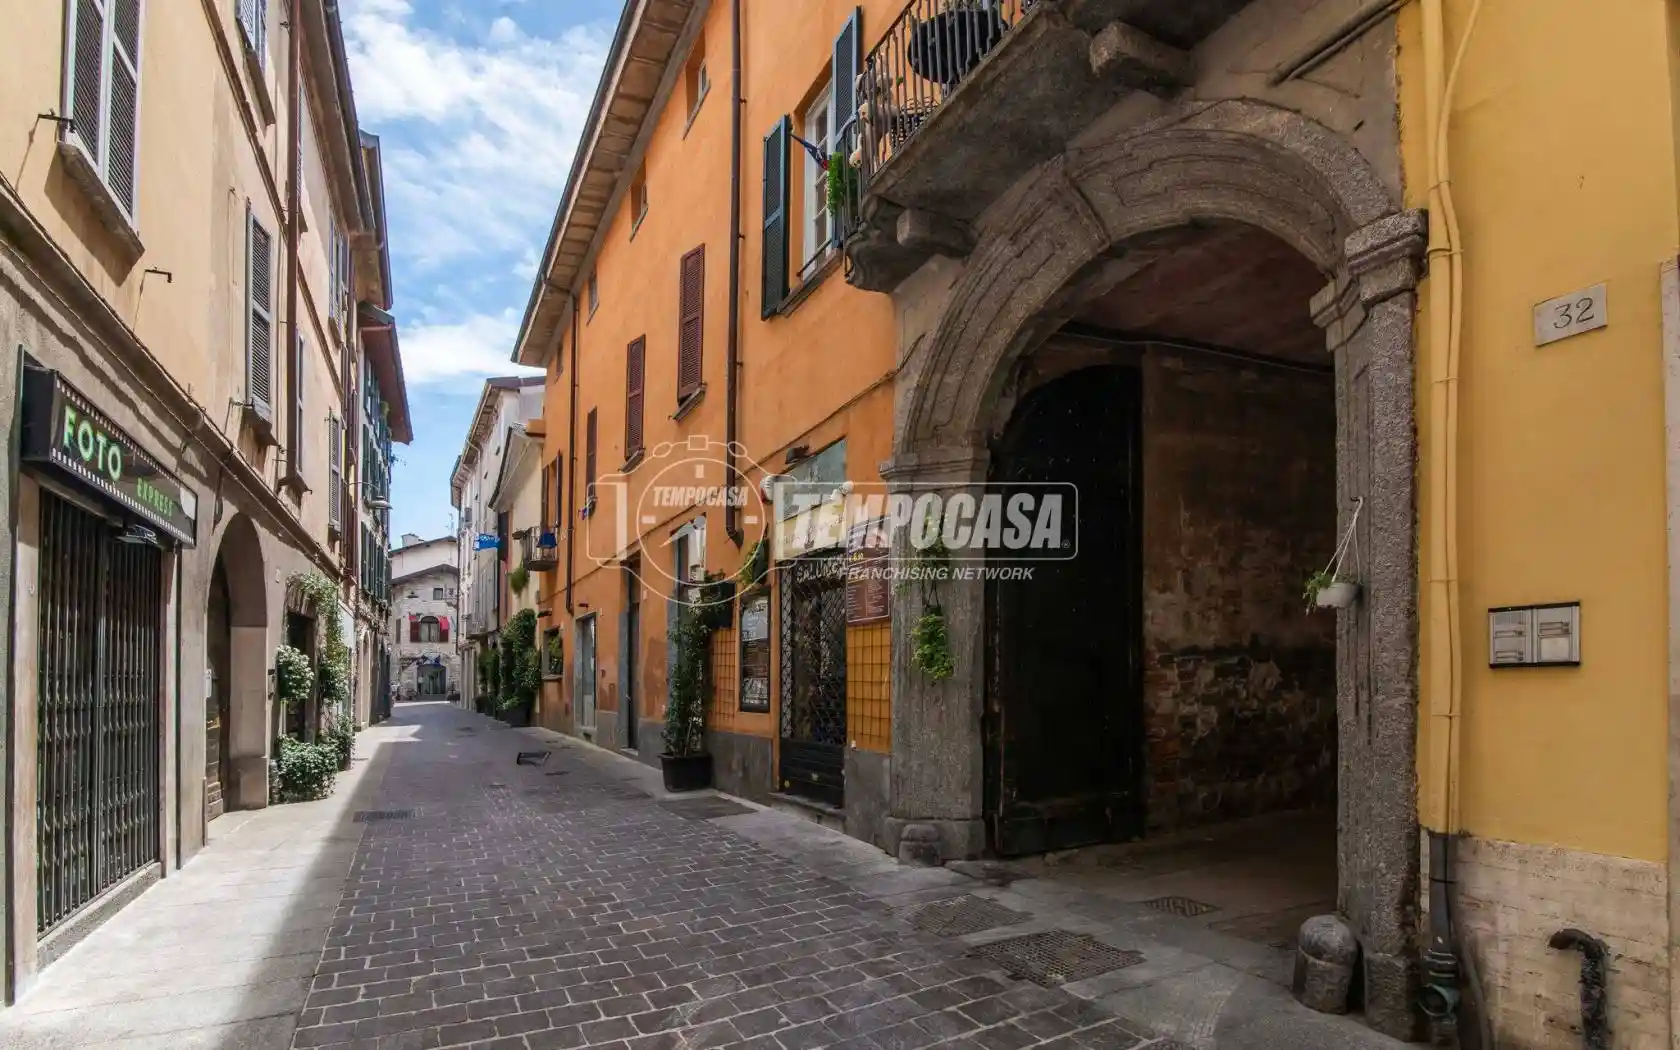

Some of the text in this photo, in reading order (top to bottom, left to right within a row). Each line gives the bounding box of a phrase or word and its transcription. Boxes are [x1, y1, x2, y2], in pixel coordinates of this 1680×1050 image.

[1553, 297, 1595, 330] 32
[63, 404, 174, 517] FOTO EXPRESS
